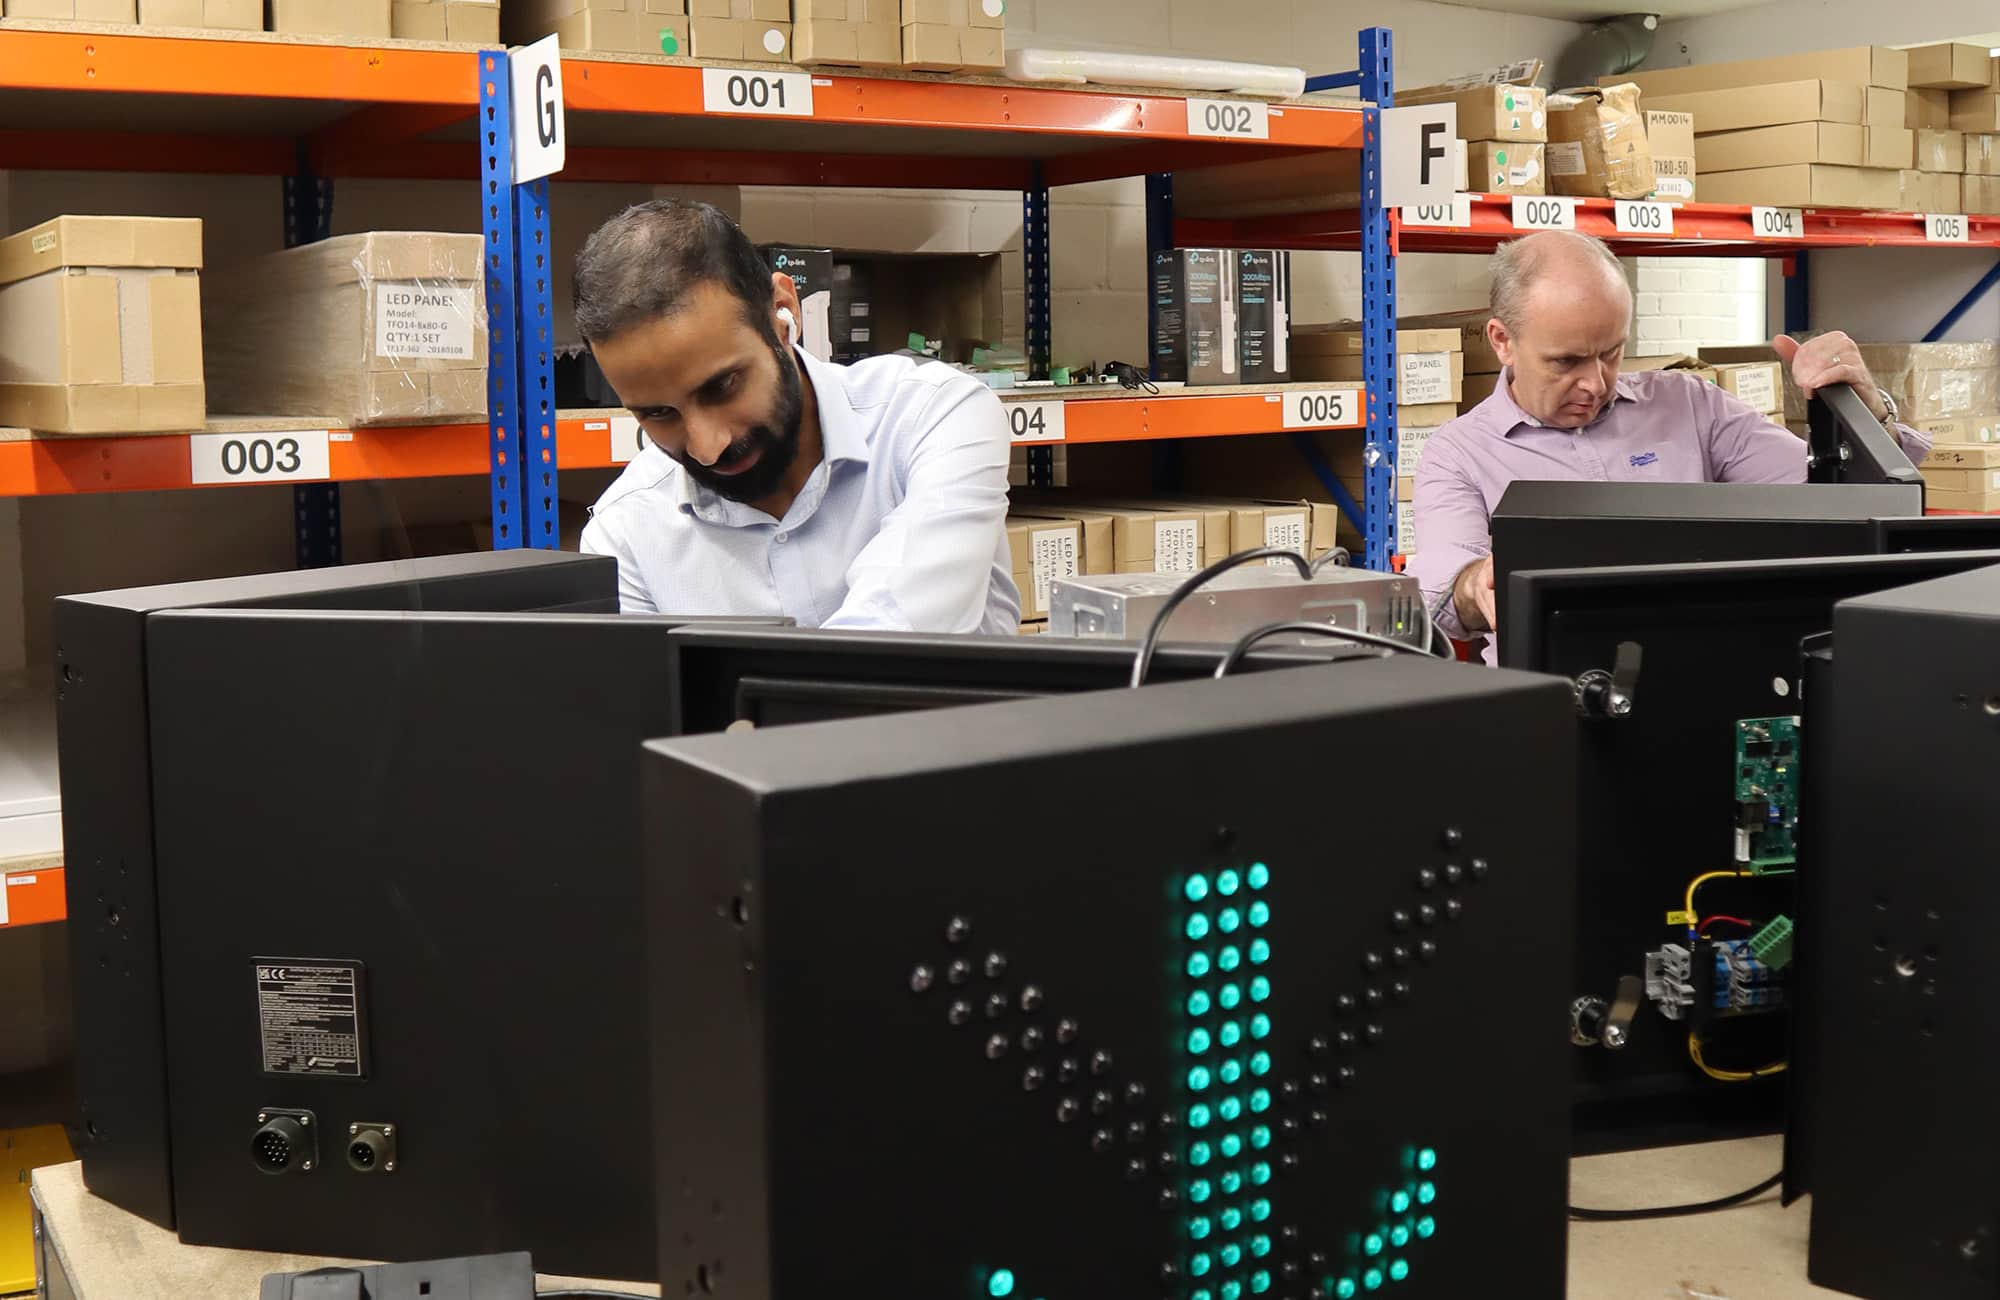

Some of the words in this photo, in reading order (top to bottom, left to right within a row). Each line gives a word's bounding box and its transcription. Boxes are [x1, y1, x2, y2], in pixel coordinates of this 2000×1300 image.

[728, 76, 784, 108] 001
[536, 64, 556, 148] G
[1205, 104, 1251, 132] 002
[1651, 114, 1689, 125] MM0014
[1421, 122, 1446, 184] F
[1526, 201, 1562, 224] 002
[1628, 206, 1661, 228] 003
[1764, 211, 1793, 233] 004
[1935, 218, 1960, 237] 005
[386, 293, 410, 305] LED
[414, 294, 453, 307] PANEL
[422, 333, 440, 343] SET
[1300, 395, 1342, 422] 005
[1004, 406, 1046, 436] 04
[222, 438, 300, 475] 003
[1064, 537, 1072, 558] LED
[1186, 528, 1194, 548] LED
